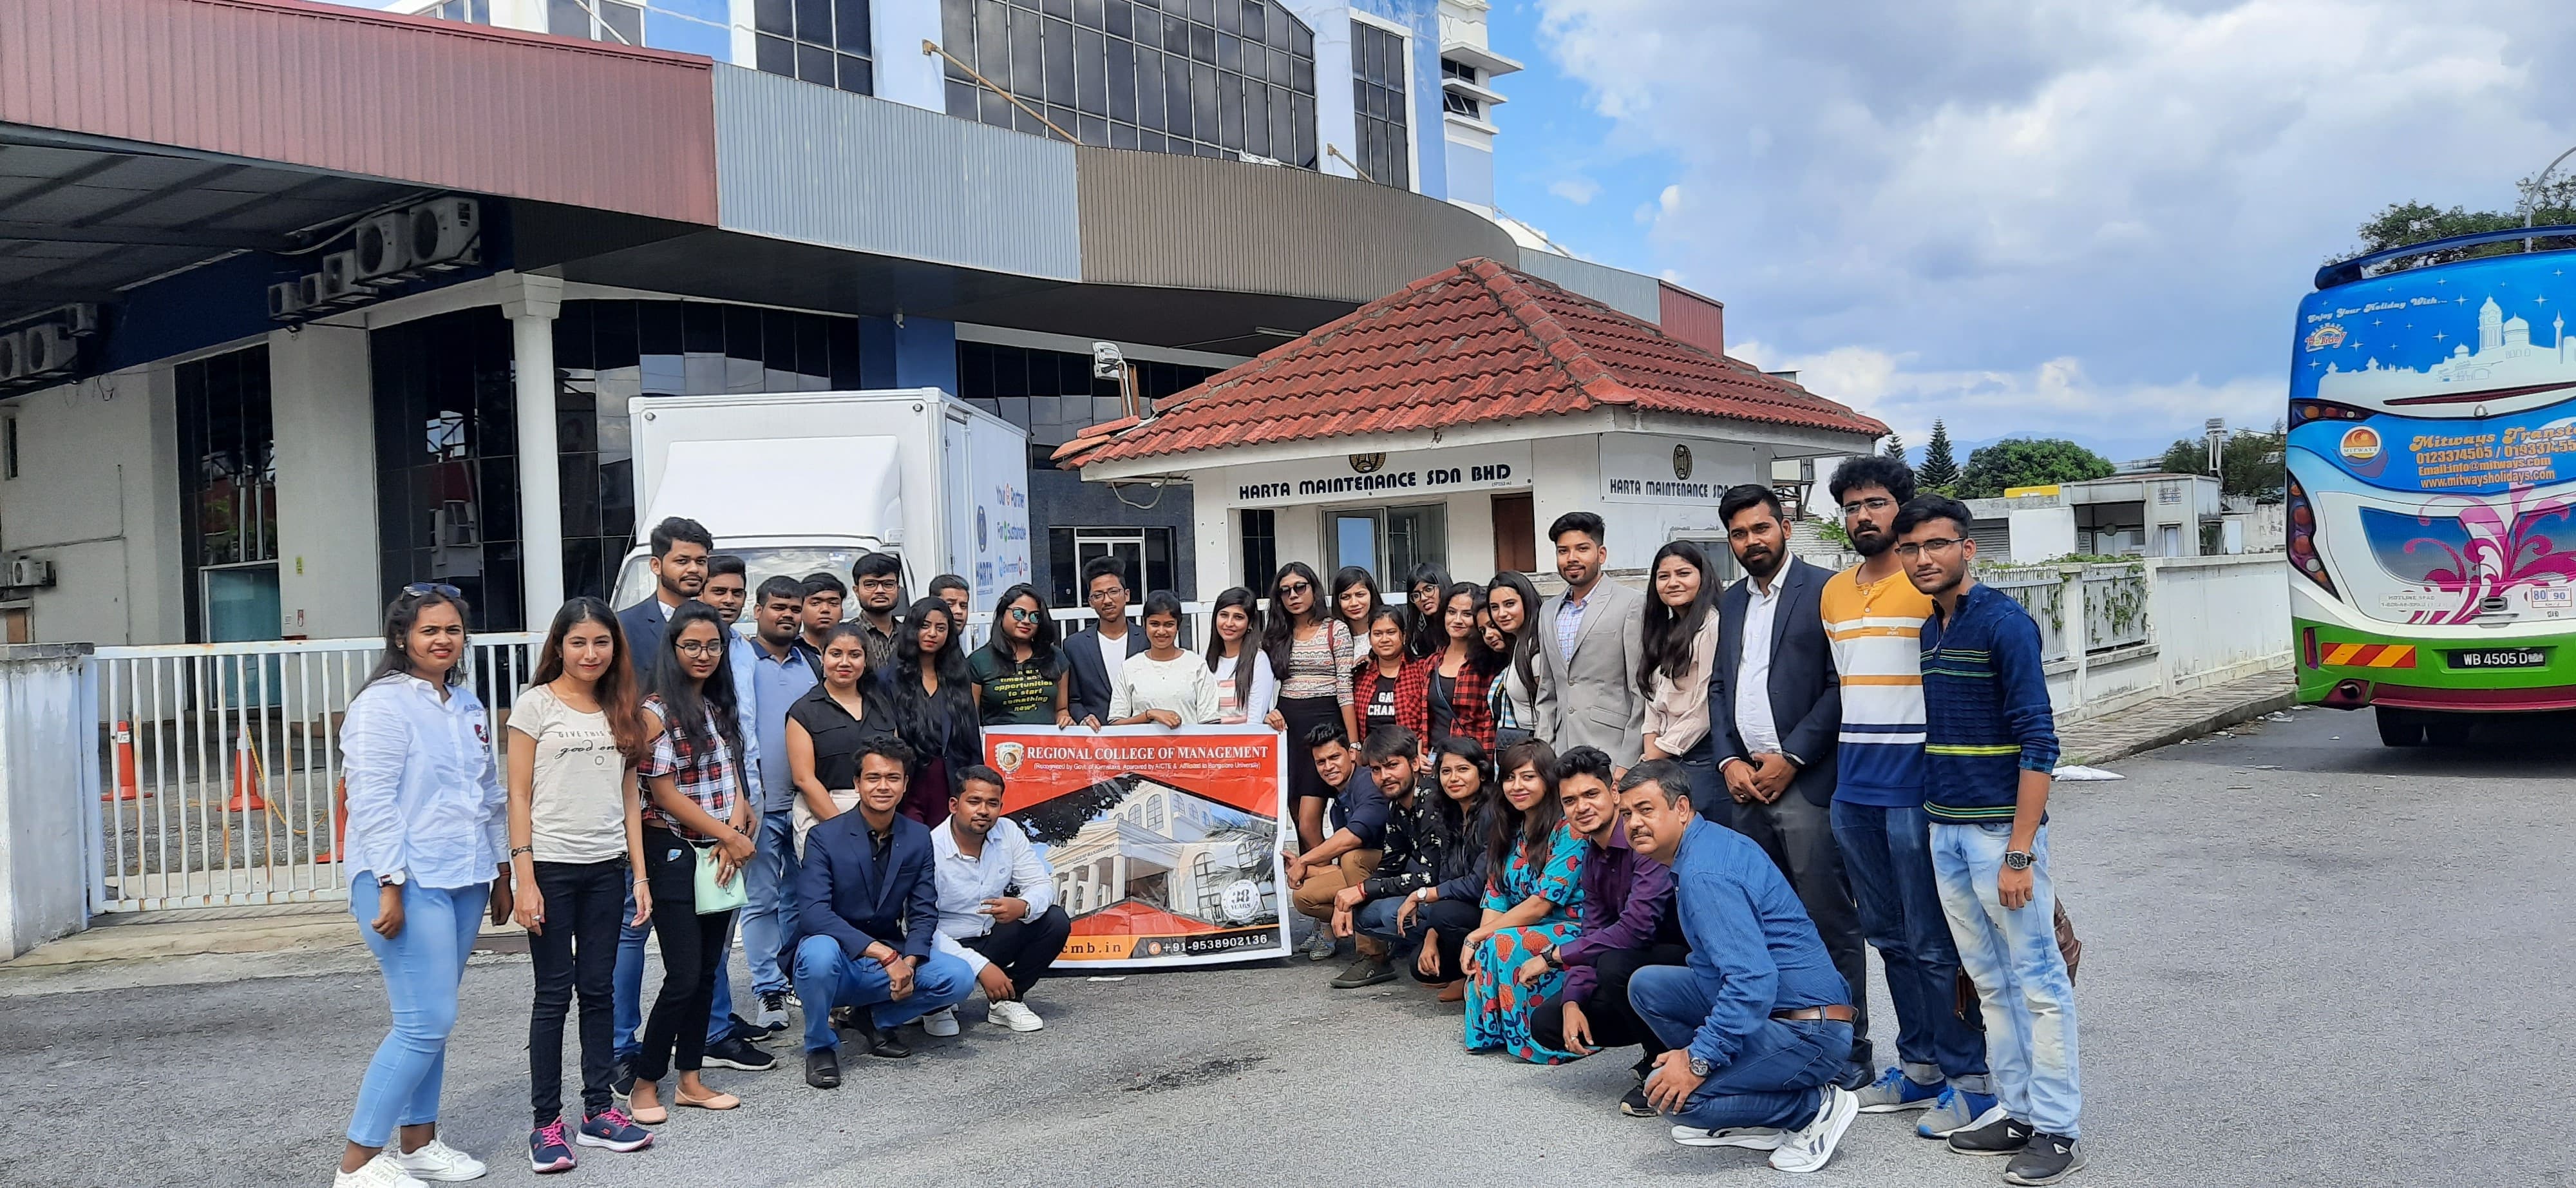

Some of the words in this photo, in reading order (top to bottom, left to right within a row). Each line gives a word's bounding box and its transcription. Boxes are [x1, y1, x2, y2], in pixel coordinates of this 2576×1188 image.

[2307, 312, 2333, 323] Enjoy
[2336, 307, 2362, 318] Your
[2363, 301, 2406, 313] Holiday
[2409, 433, 2496, 451] Mitways
[1239, 482, 1291, 499] HARTA
[1299, 472, 1416, 495] MAINTENANCE
[1426, 468, 1461, 486] SDN
[1471, 464, 1511, 482] BHD
[2421, 468, 2555, 488] www.mitwaysholidays.com
[995, 484, 1005, 506] Your
[1010, 487, 1025, 508] Partner
[1610, 479, 1641, 495] HARTA
[1645, 481, 1708, 497] MAINTENANCE
[976, 562, 992, 588] HARTA
[2533, 590, 2546, 600] 80
[2463, 653, 2481, 665] WB
[2483, 653, 2517, 665] 4505
[2519, 653, 2527, 664] D
[994, 680, 1053, 691] opportunities
[1003, 696, 1048, 705] something
[554, 739, 592, 760] good
[1027, 747, 1092, 760] REGIONAL
[1095, 747, 1155, 760] COLLEGE
[1158, 747, 1175, 760] OF
[1178, 746, 1268, 759] MANAGEMENT
[1163, 934, 1267, 952] +91-9538902136
